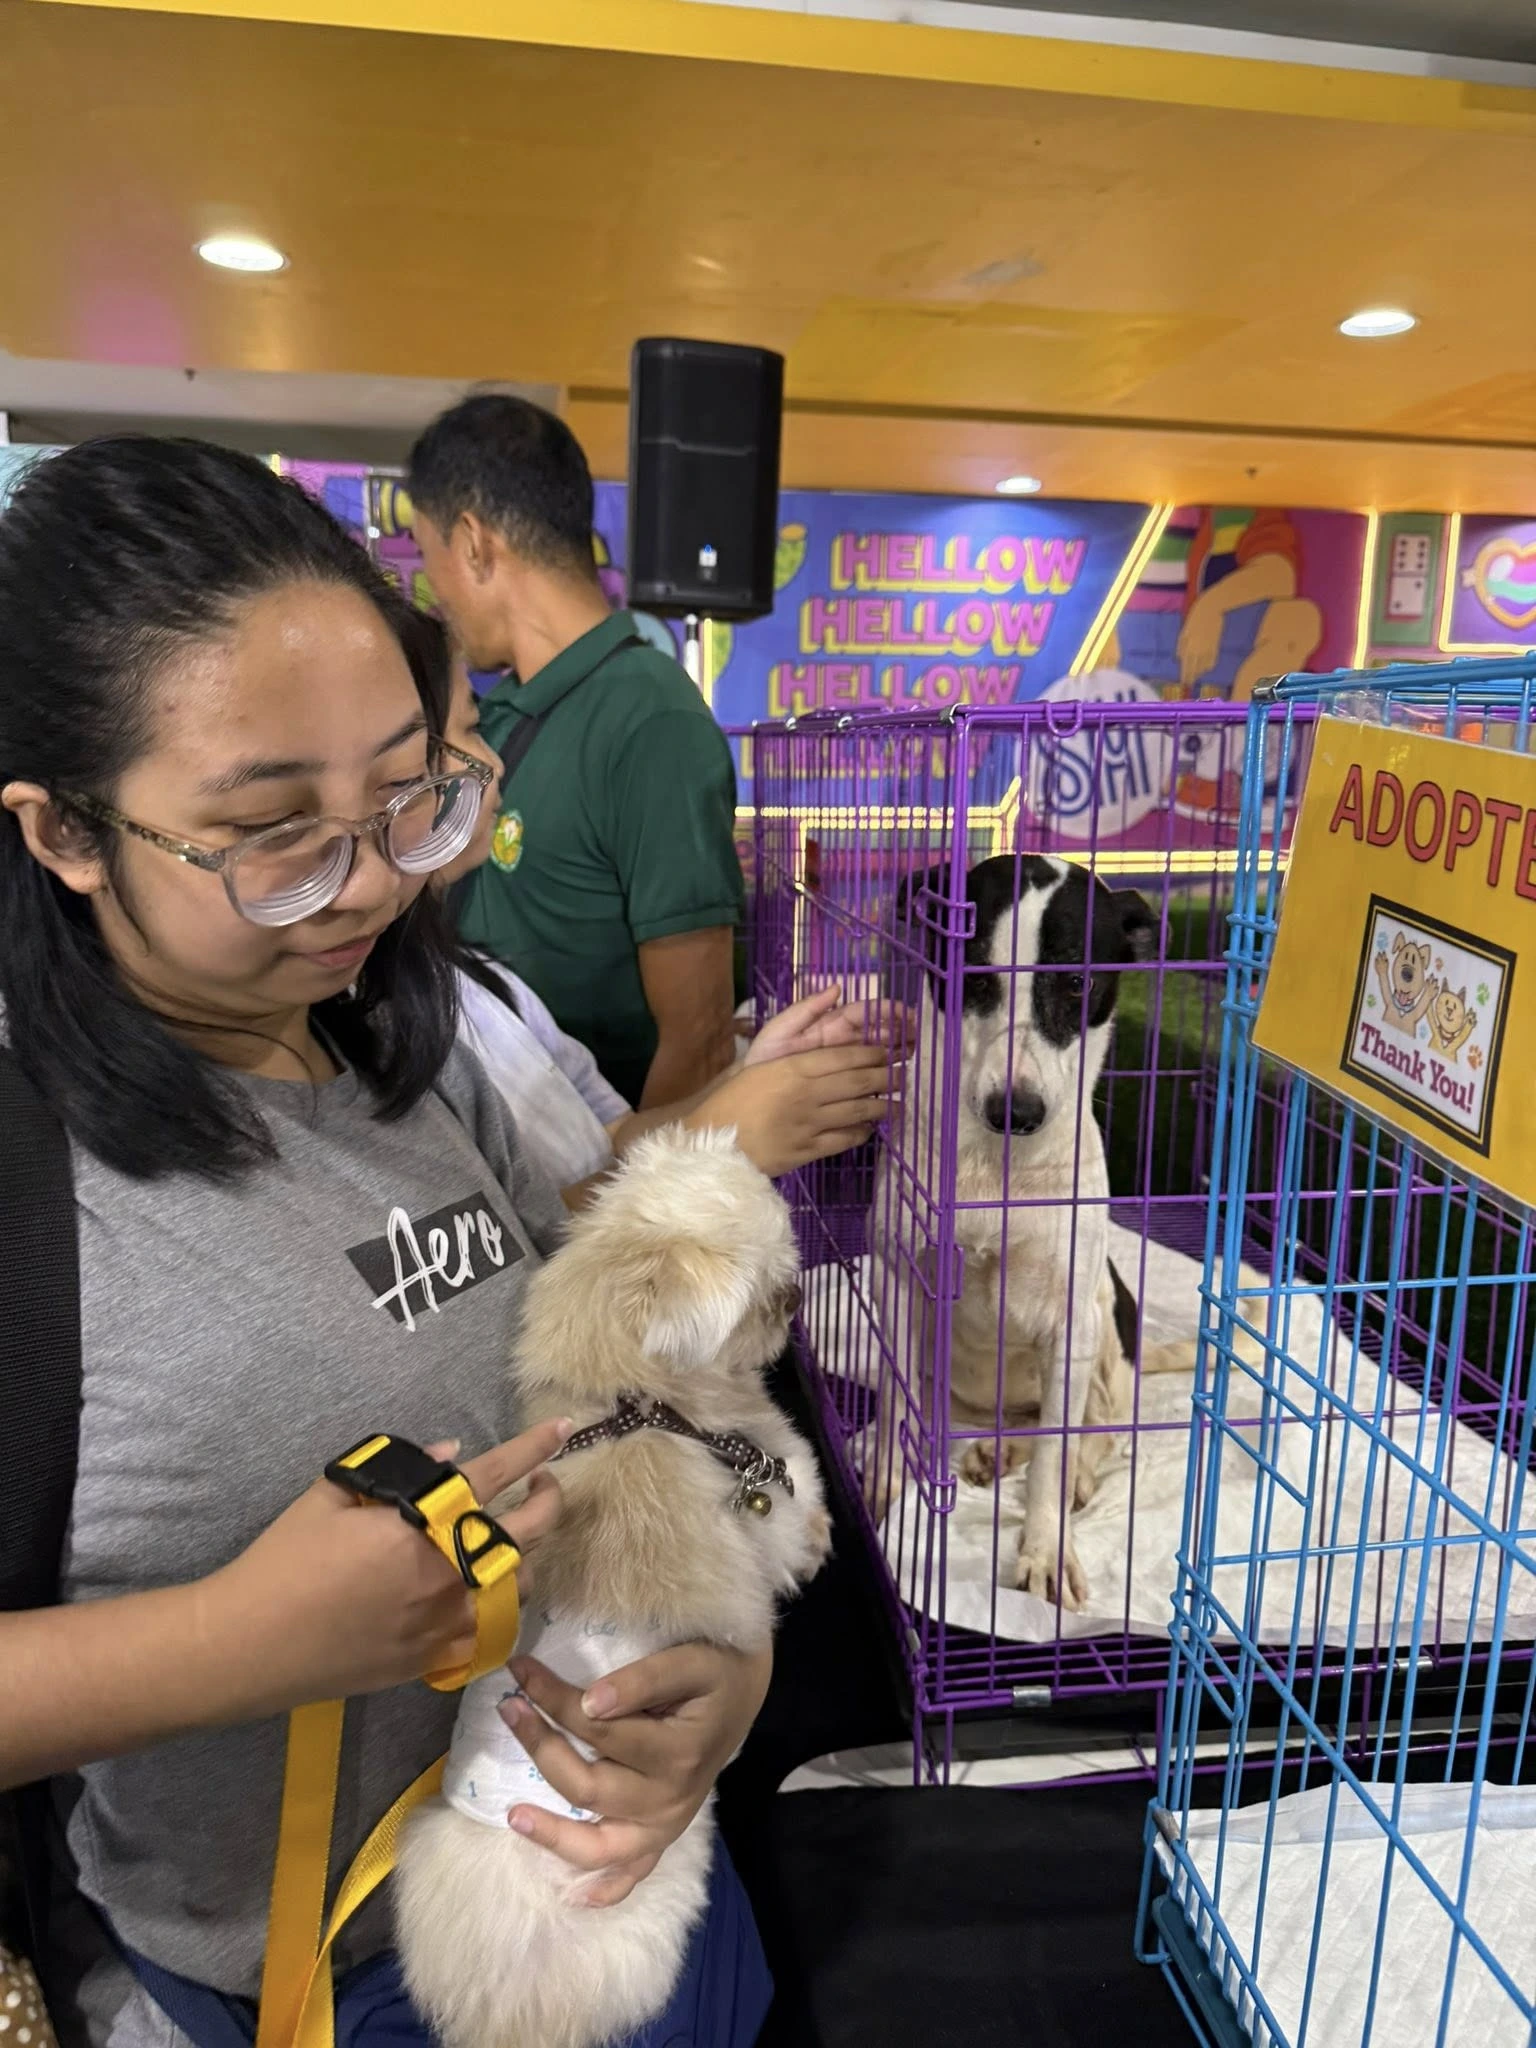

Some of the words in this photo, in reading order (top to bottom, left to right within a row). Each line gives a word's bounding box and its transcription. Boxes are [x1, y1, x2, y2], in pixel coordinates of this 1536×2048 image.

[831, 534, 1087, 592] HELLOW
[801, 597, 1055, 656] HELLOW
[769, 663, 1022, 717] HELLOW
[1360, 1022, 1427, 1085] Thank
[1429, 1058, 1475, 1114] You!
[371, 1206, 505, 1332] Aero
